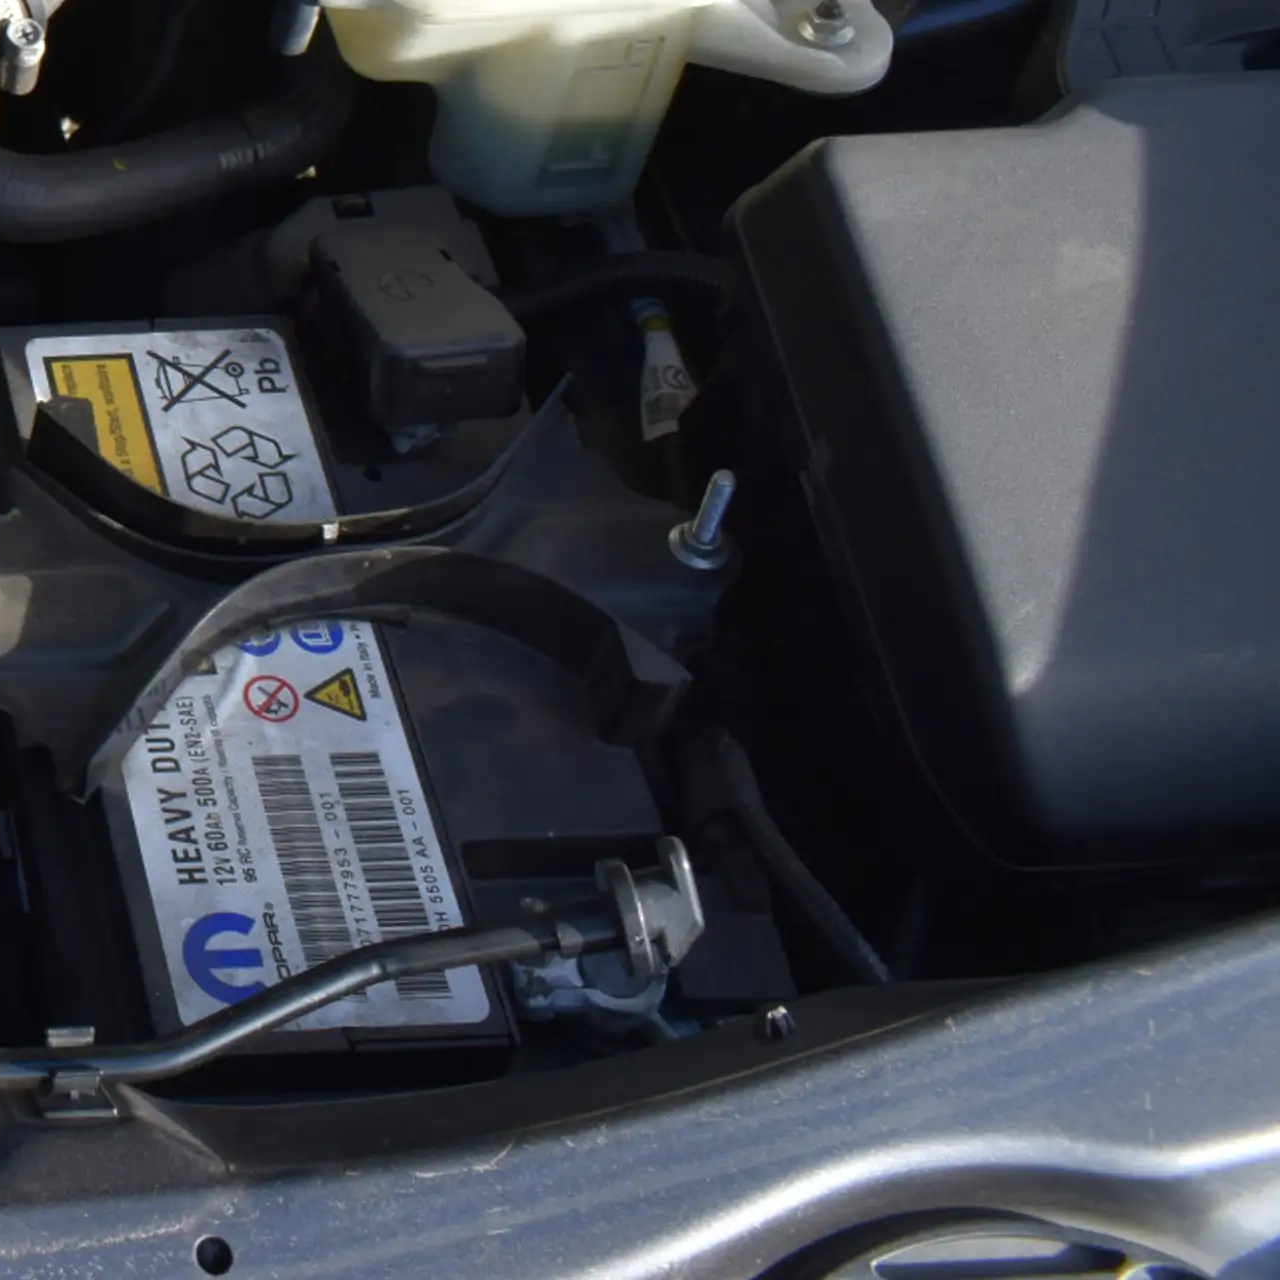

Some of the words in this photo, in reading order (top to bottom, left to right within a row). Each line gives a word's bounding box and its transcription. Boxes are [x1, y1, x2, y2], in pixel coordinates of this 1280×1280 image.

[254, 357, 289, 394] Pb
[366, 673, 382, 699] Made
[144, 708, 182, 774] DUT
[396, 789, 416, 816] 001
[156, 787, 210, 886] HEAVY
[412, 835, 430, 859] AA
[420, 864, 444, 905] 5505
[262, 911, 292, 980] OPAR
